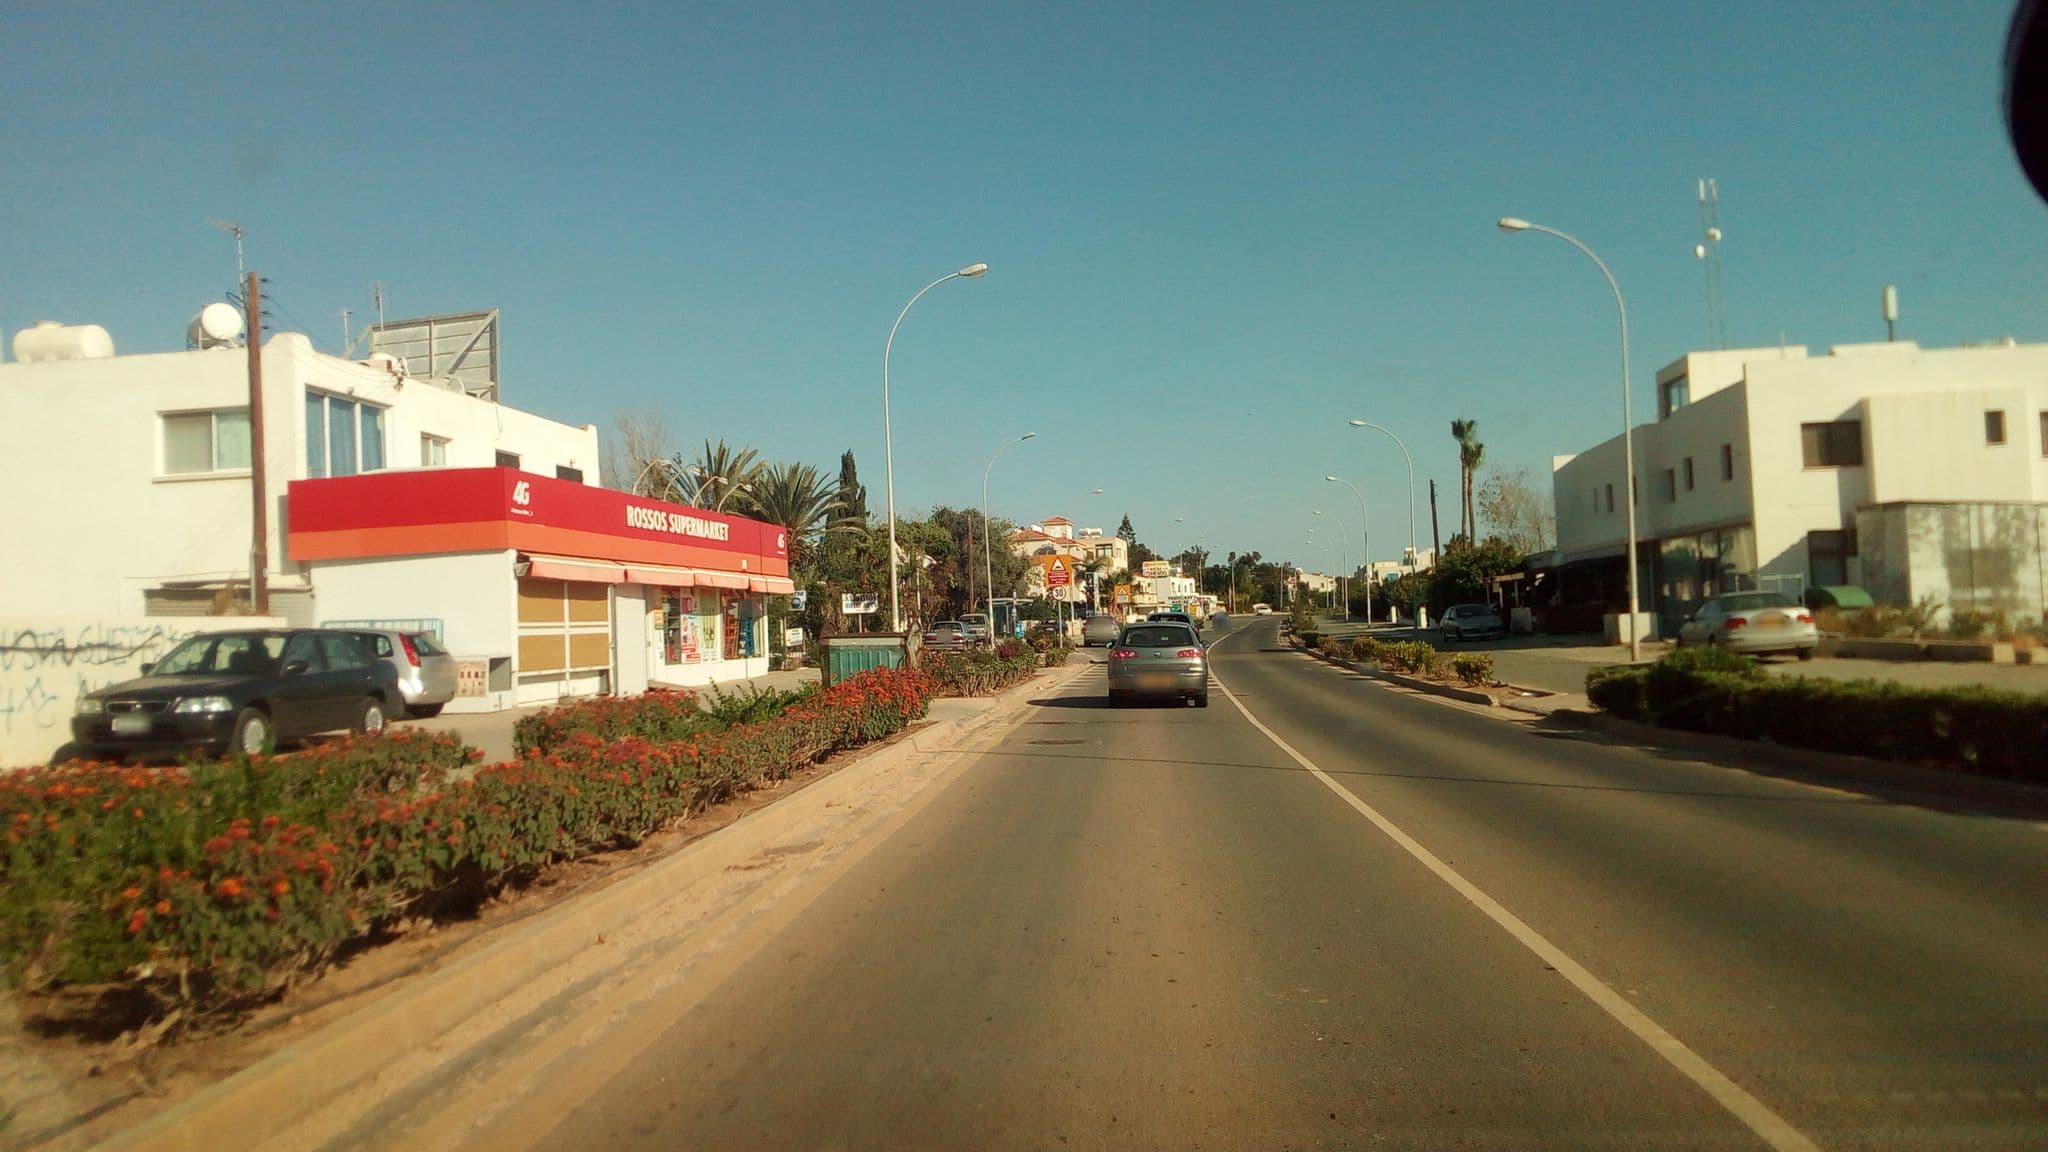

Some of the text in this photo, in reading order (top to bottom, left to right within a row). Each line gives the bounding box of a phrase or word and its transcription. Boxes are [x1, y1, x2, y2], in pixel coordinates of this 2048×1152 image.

[513, 480, 530, 505] 4G
[626, 505, 729, 541] ROSSOS SUPERMARKET
[1054, 588, 1064, 598] 30
